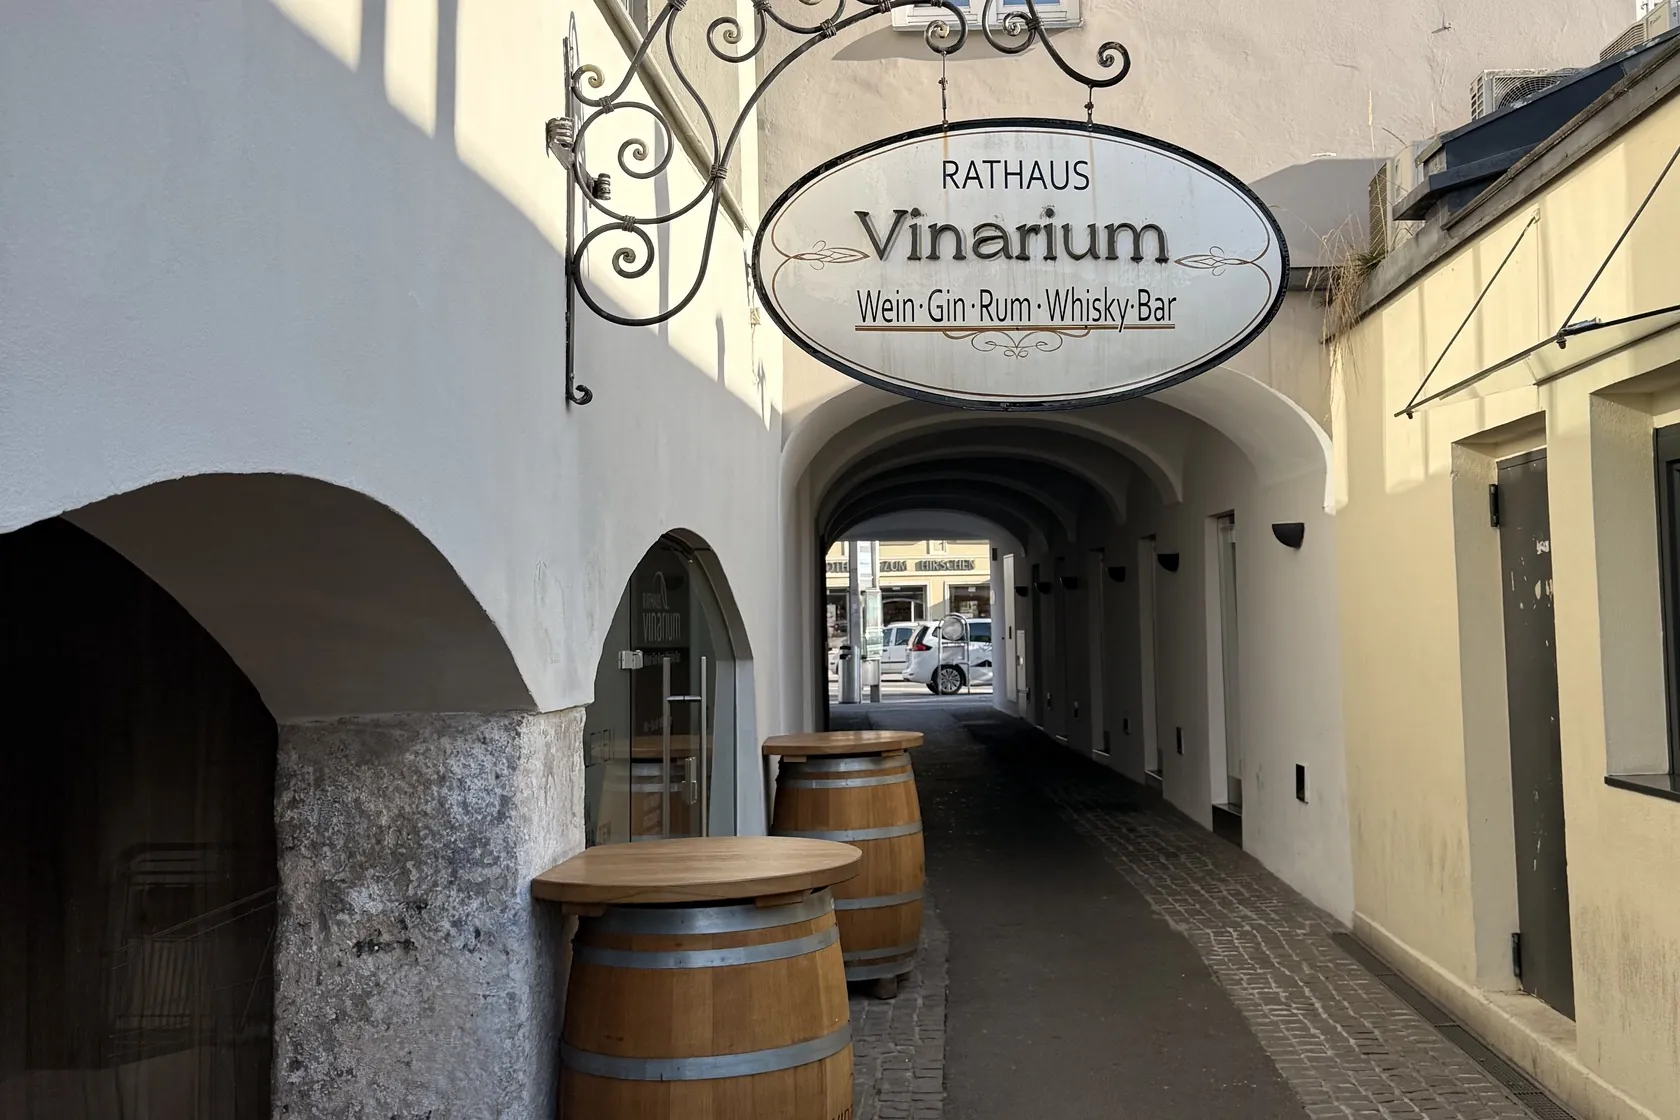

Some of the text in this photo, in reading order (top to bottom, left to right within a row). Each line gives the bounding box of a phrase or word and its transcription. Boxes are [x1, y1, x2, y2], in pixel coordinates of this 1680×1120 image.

[942, 160, 1090, 191] RATHAUS
[854, 207, 1170, 262] Vinarium
[923, 559, 977, 572] HIRSCHEN
